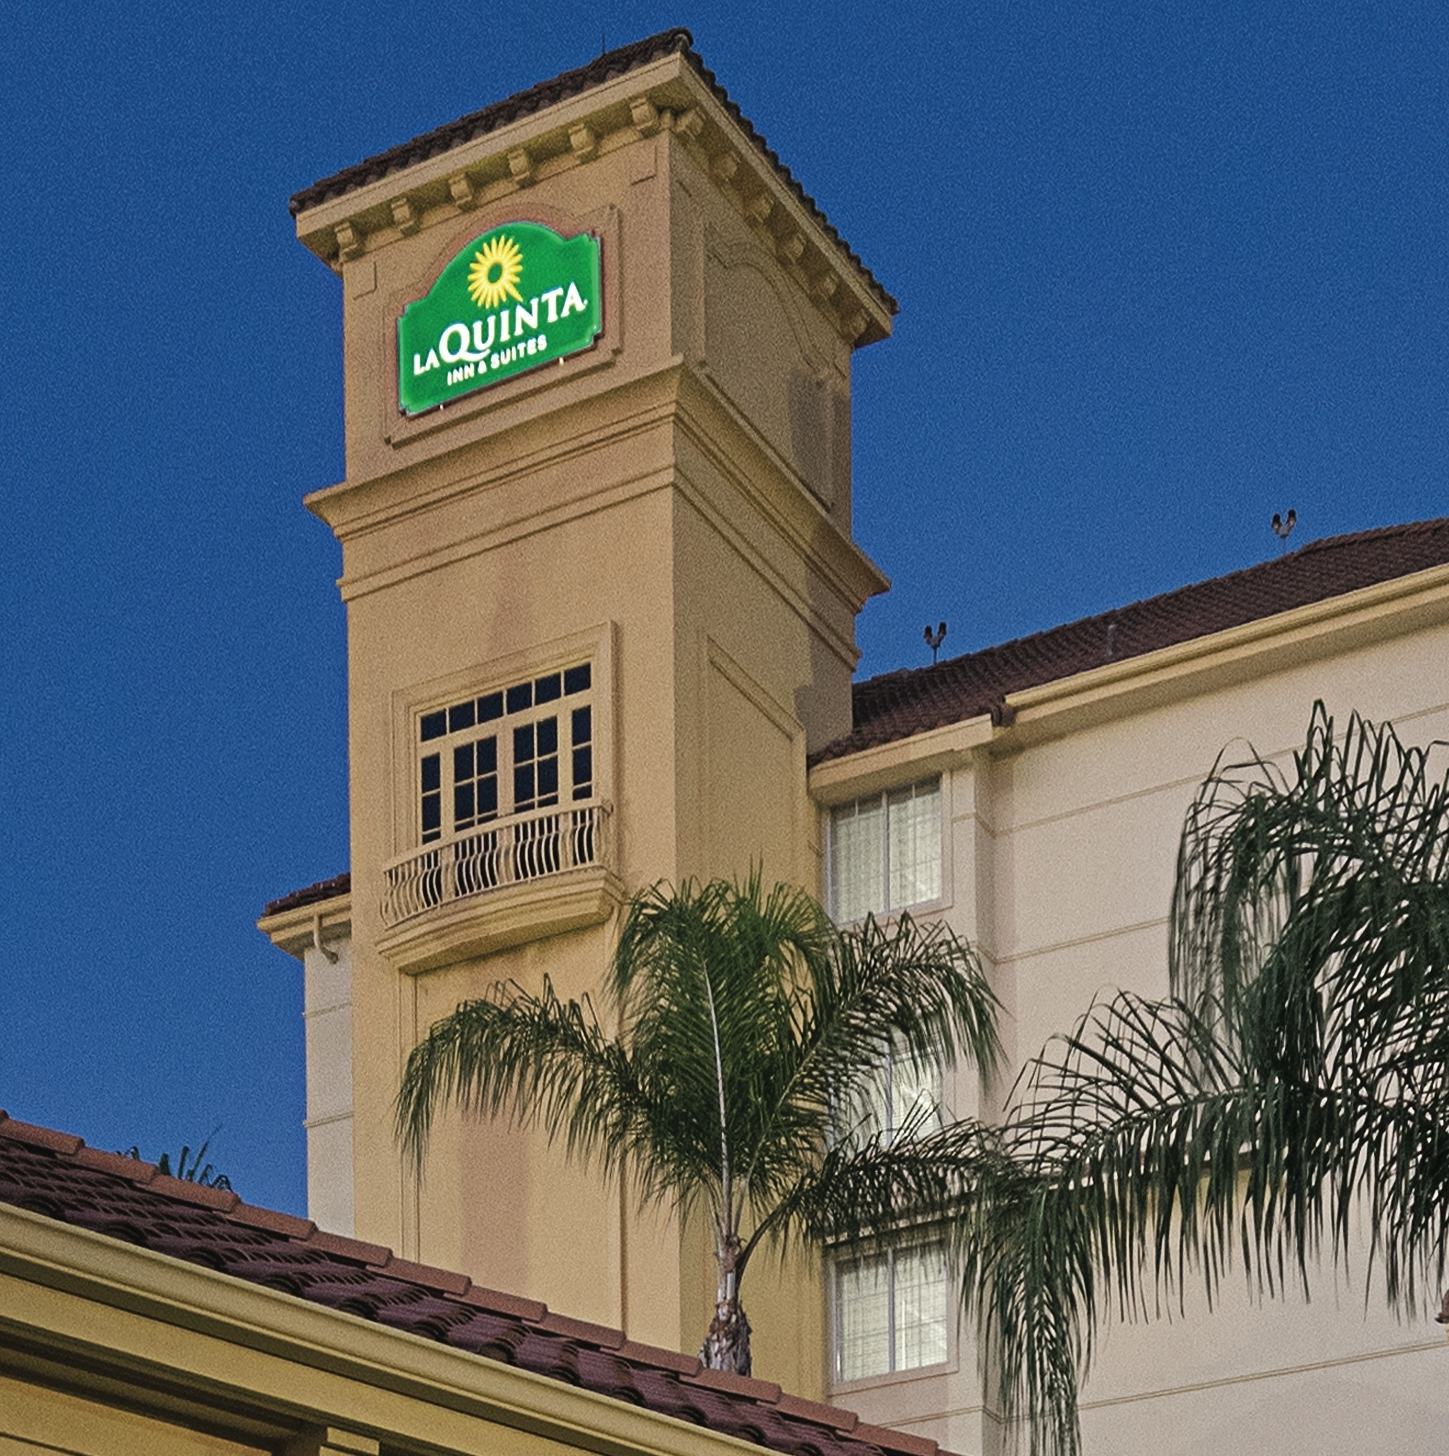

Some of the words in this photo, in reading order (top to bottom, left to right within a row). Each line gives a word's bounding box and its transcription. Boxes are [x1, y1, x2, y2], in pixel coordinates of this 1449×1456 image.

[438, 281, 585, 363] QUINTA
[447, 361, 475, 386] INN
[478, 360, 488, 374] &
[490, 334, 548, 370] SUITES
